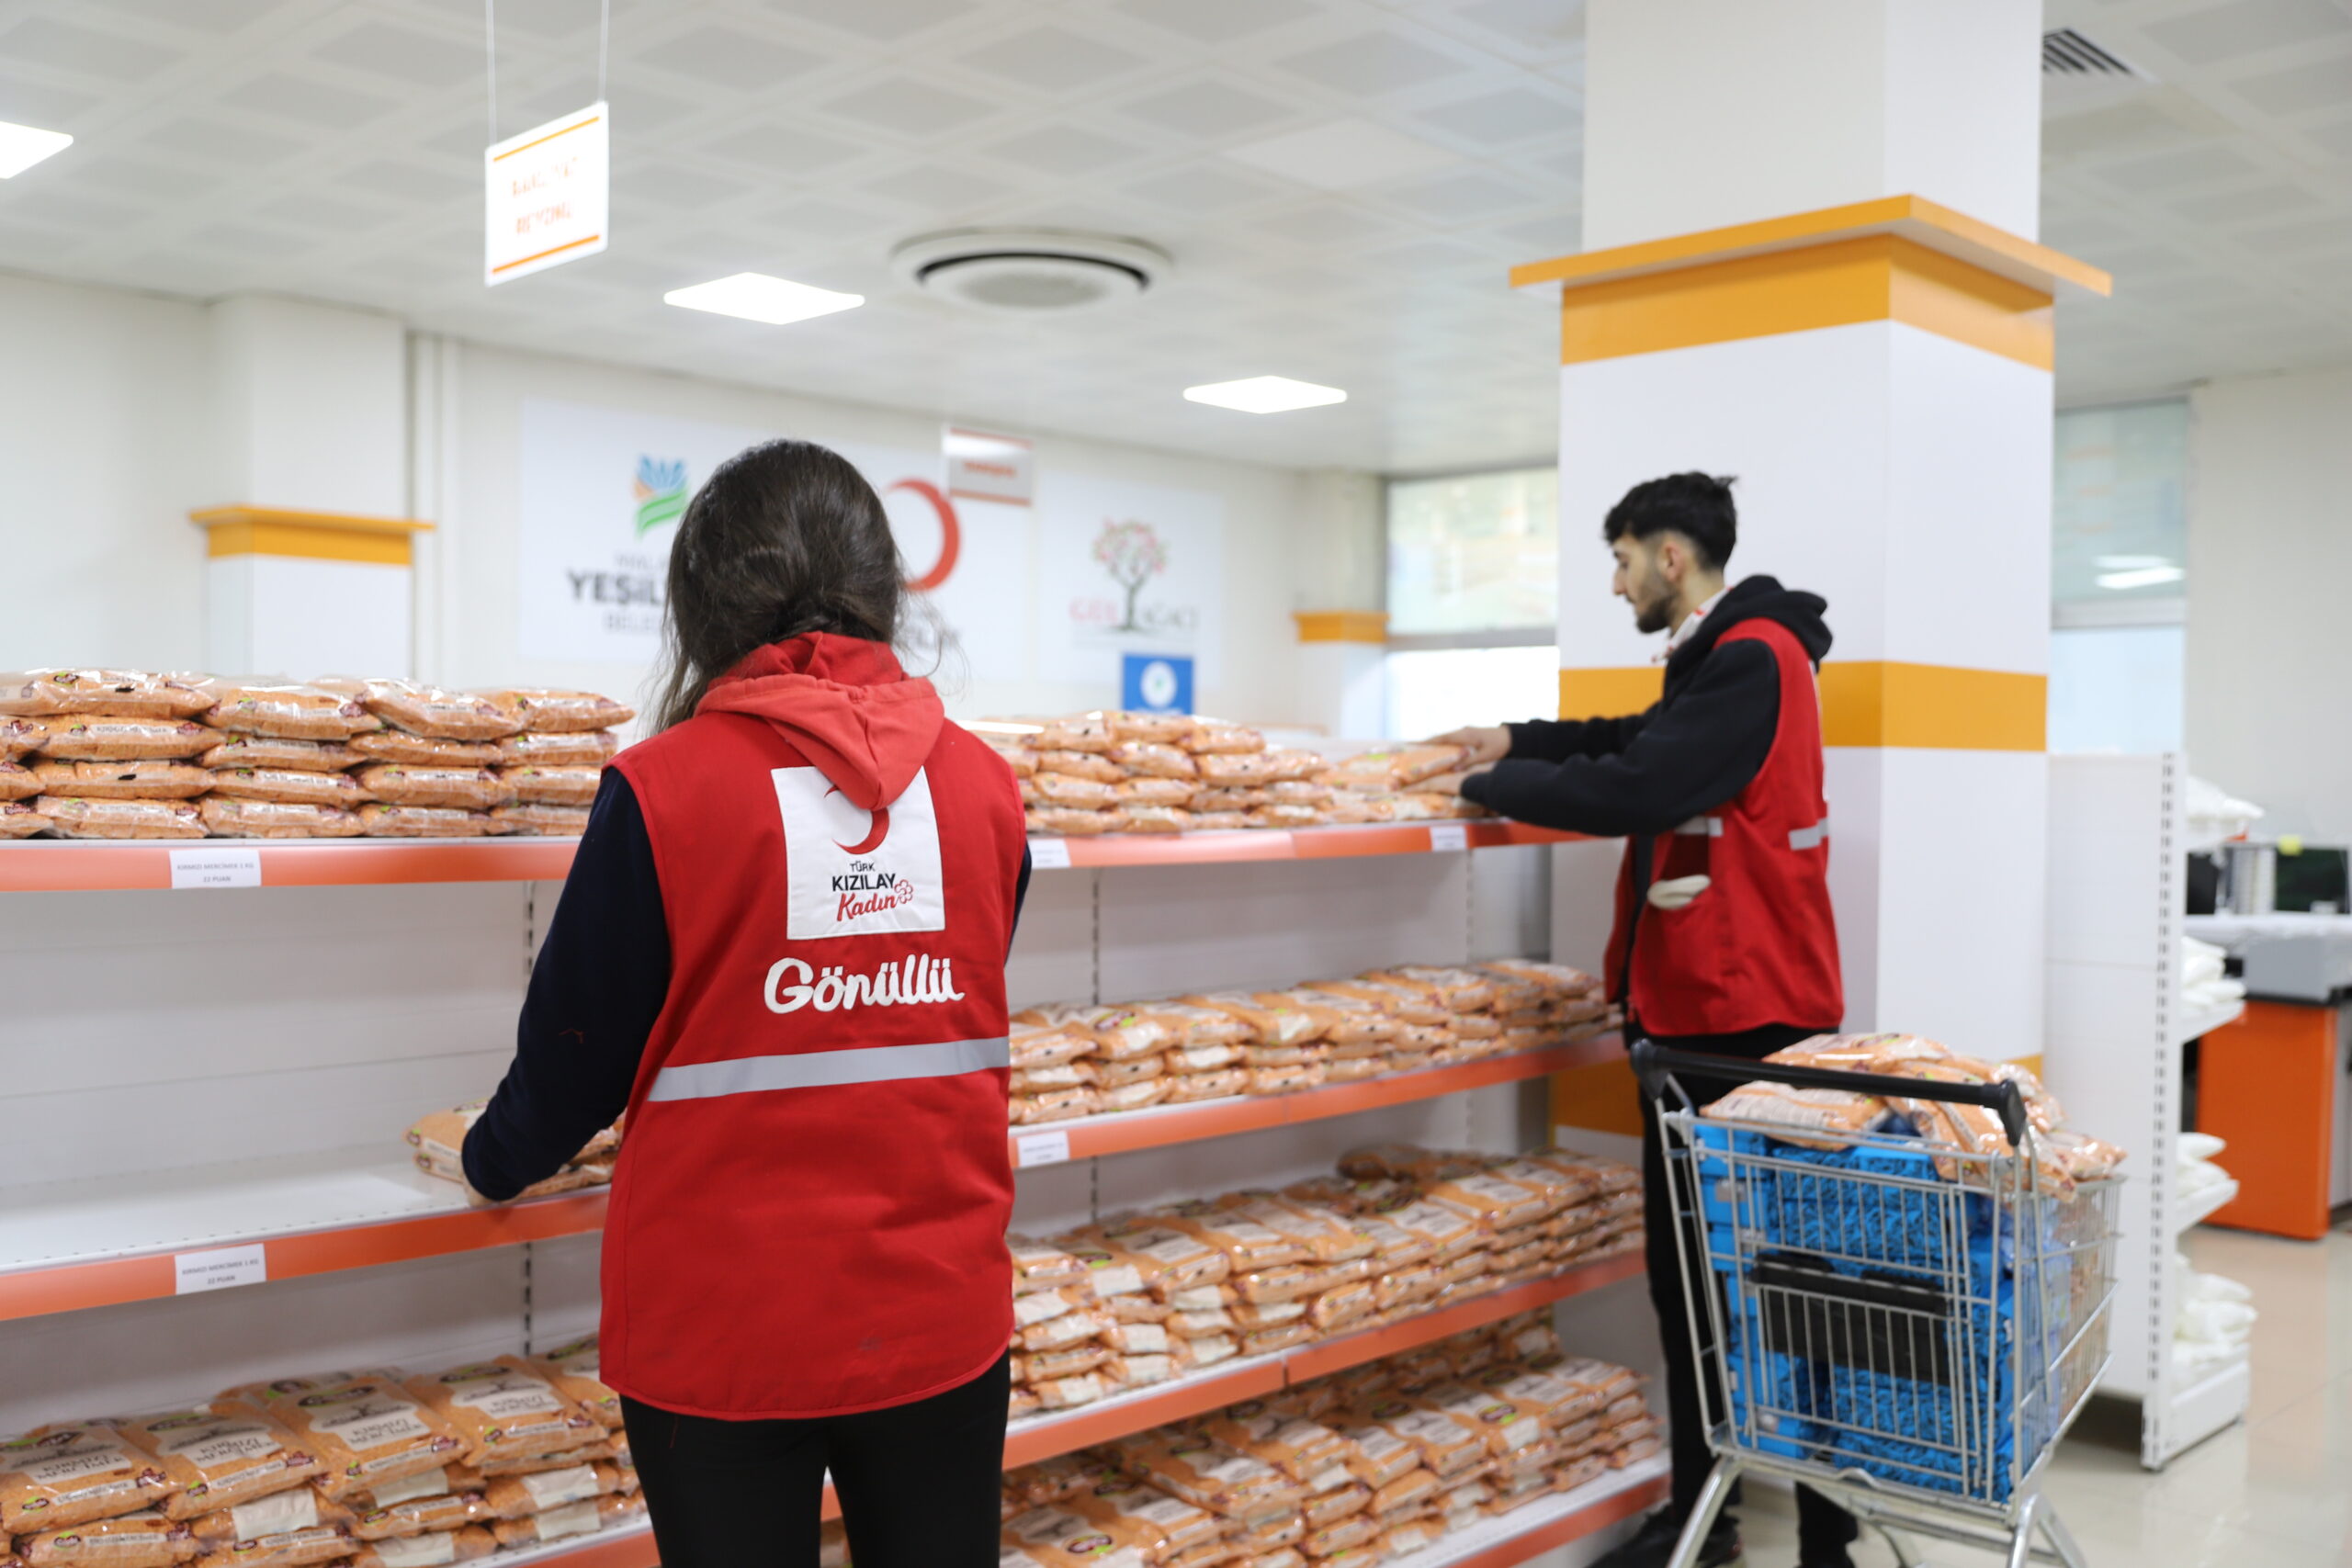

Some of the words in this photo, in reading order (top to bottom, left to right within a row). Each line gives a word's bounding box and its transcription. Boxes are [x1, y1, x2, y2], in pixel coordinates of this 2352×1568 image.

[567, 570, 663, 606] YEŞİL
[850, 860, 876, 872] TÜRK
[831, 873, 897, 892] KIZILAY
[836, 892, 899, 922] Kadın
[763, 953, 966, 1014] Gönüllü
